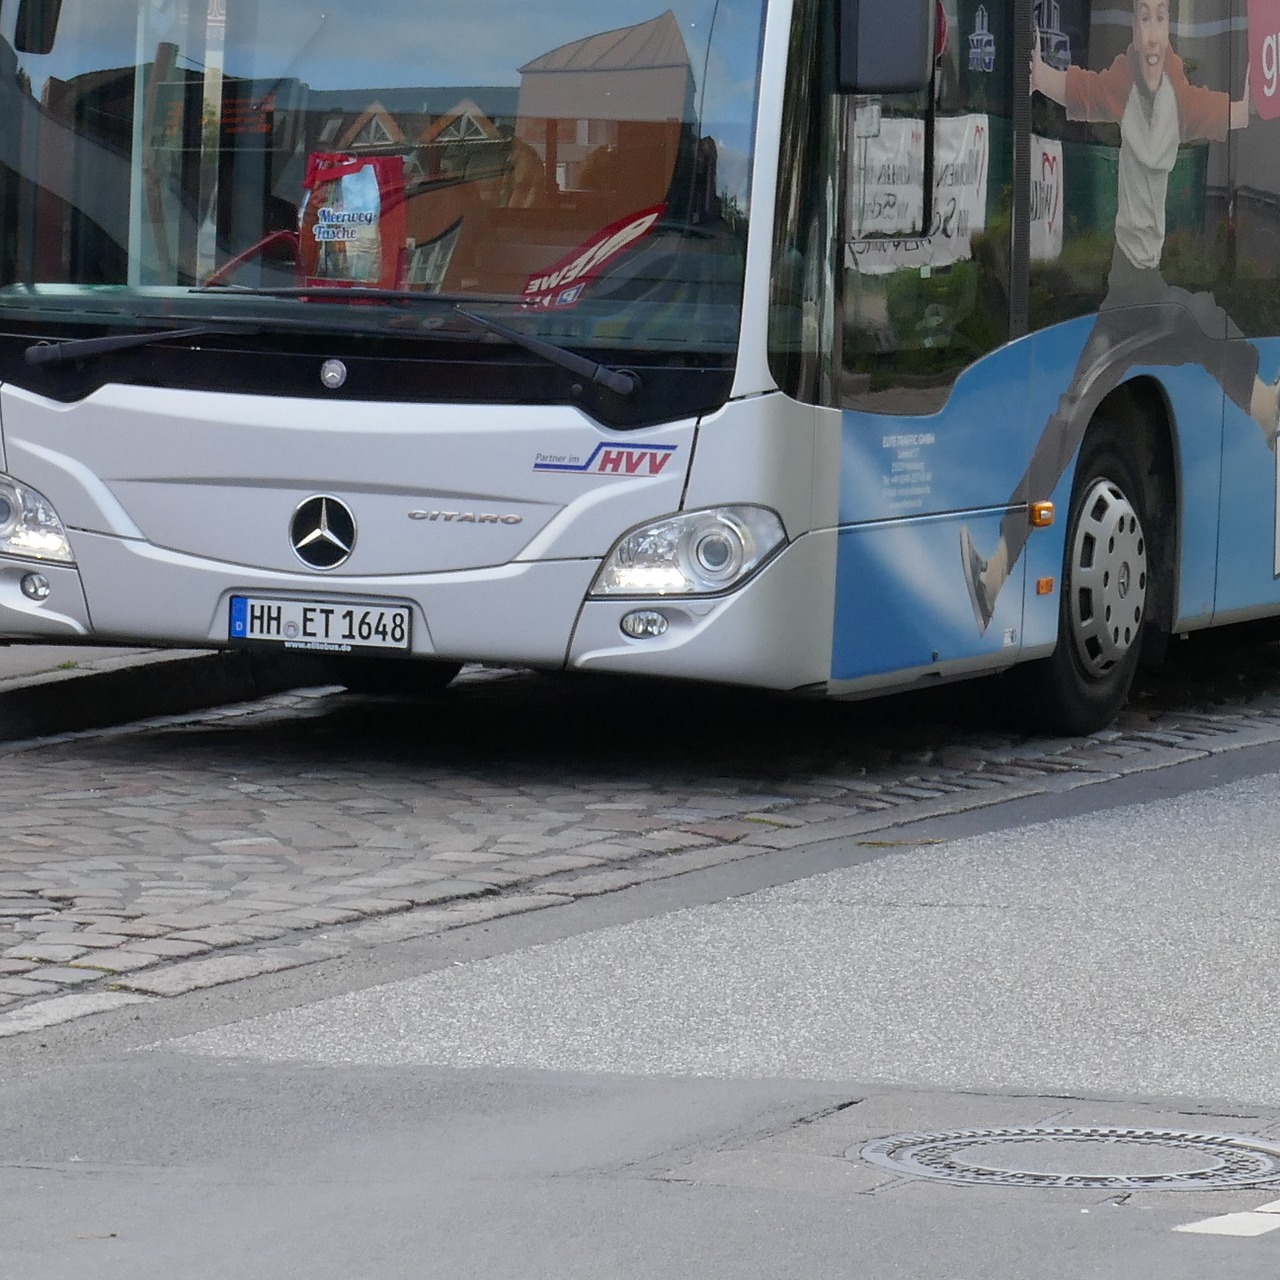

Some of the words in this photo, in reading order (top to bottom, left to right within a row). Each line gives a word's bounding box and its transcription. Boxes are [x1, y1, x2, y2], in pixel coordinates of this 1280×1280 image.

[535, 453, 566, 464] Partner
[568, 454, 580, 464] im
[597, 450, 672, 475] HVV
[407, 509, 523, 525] CITARO
[249, 604, 282, 635] HH
[302, 607, 334, 638] ET
[341, 609, 405, 643] 1648
[284, 640, 352, 653] www.elitebus.de
